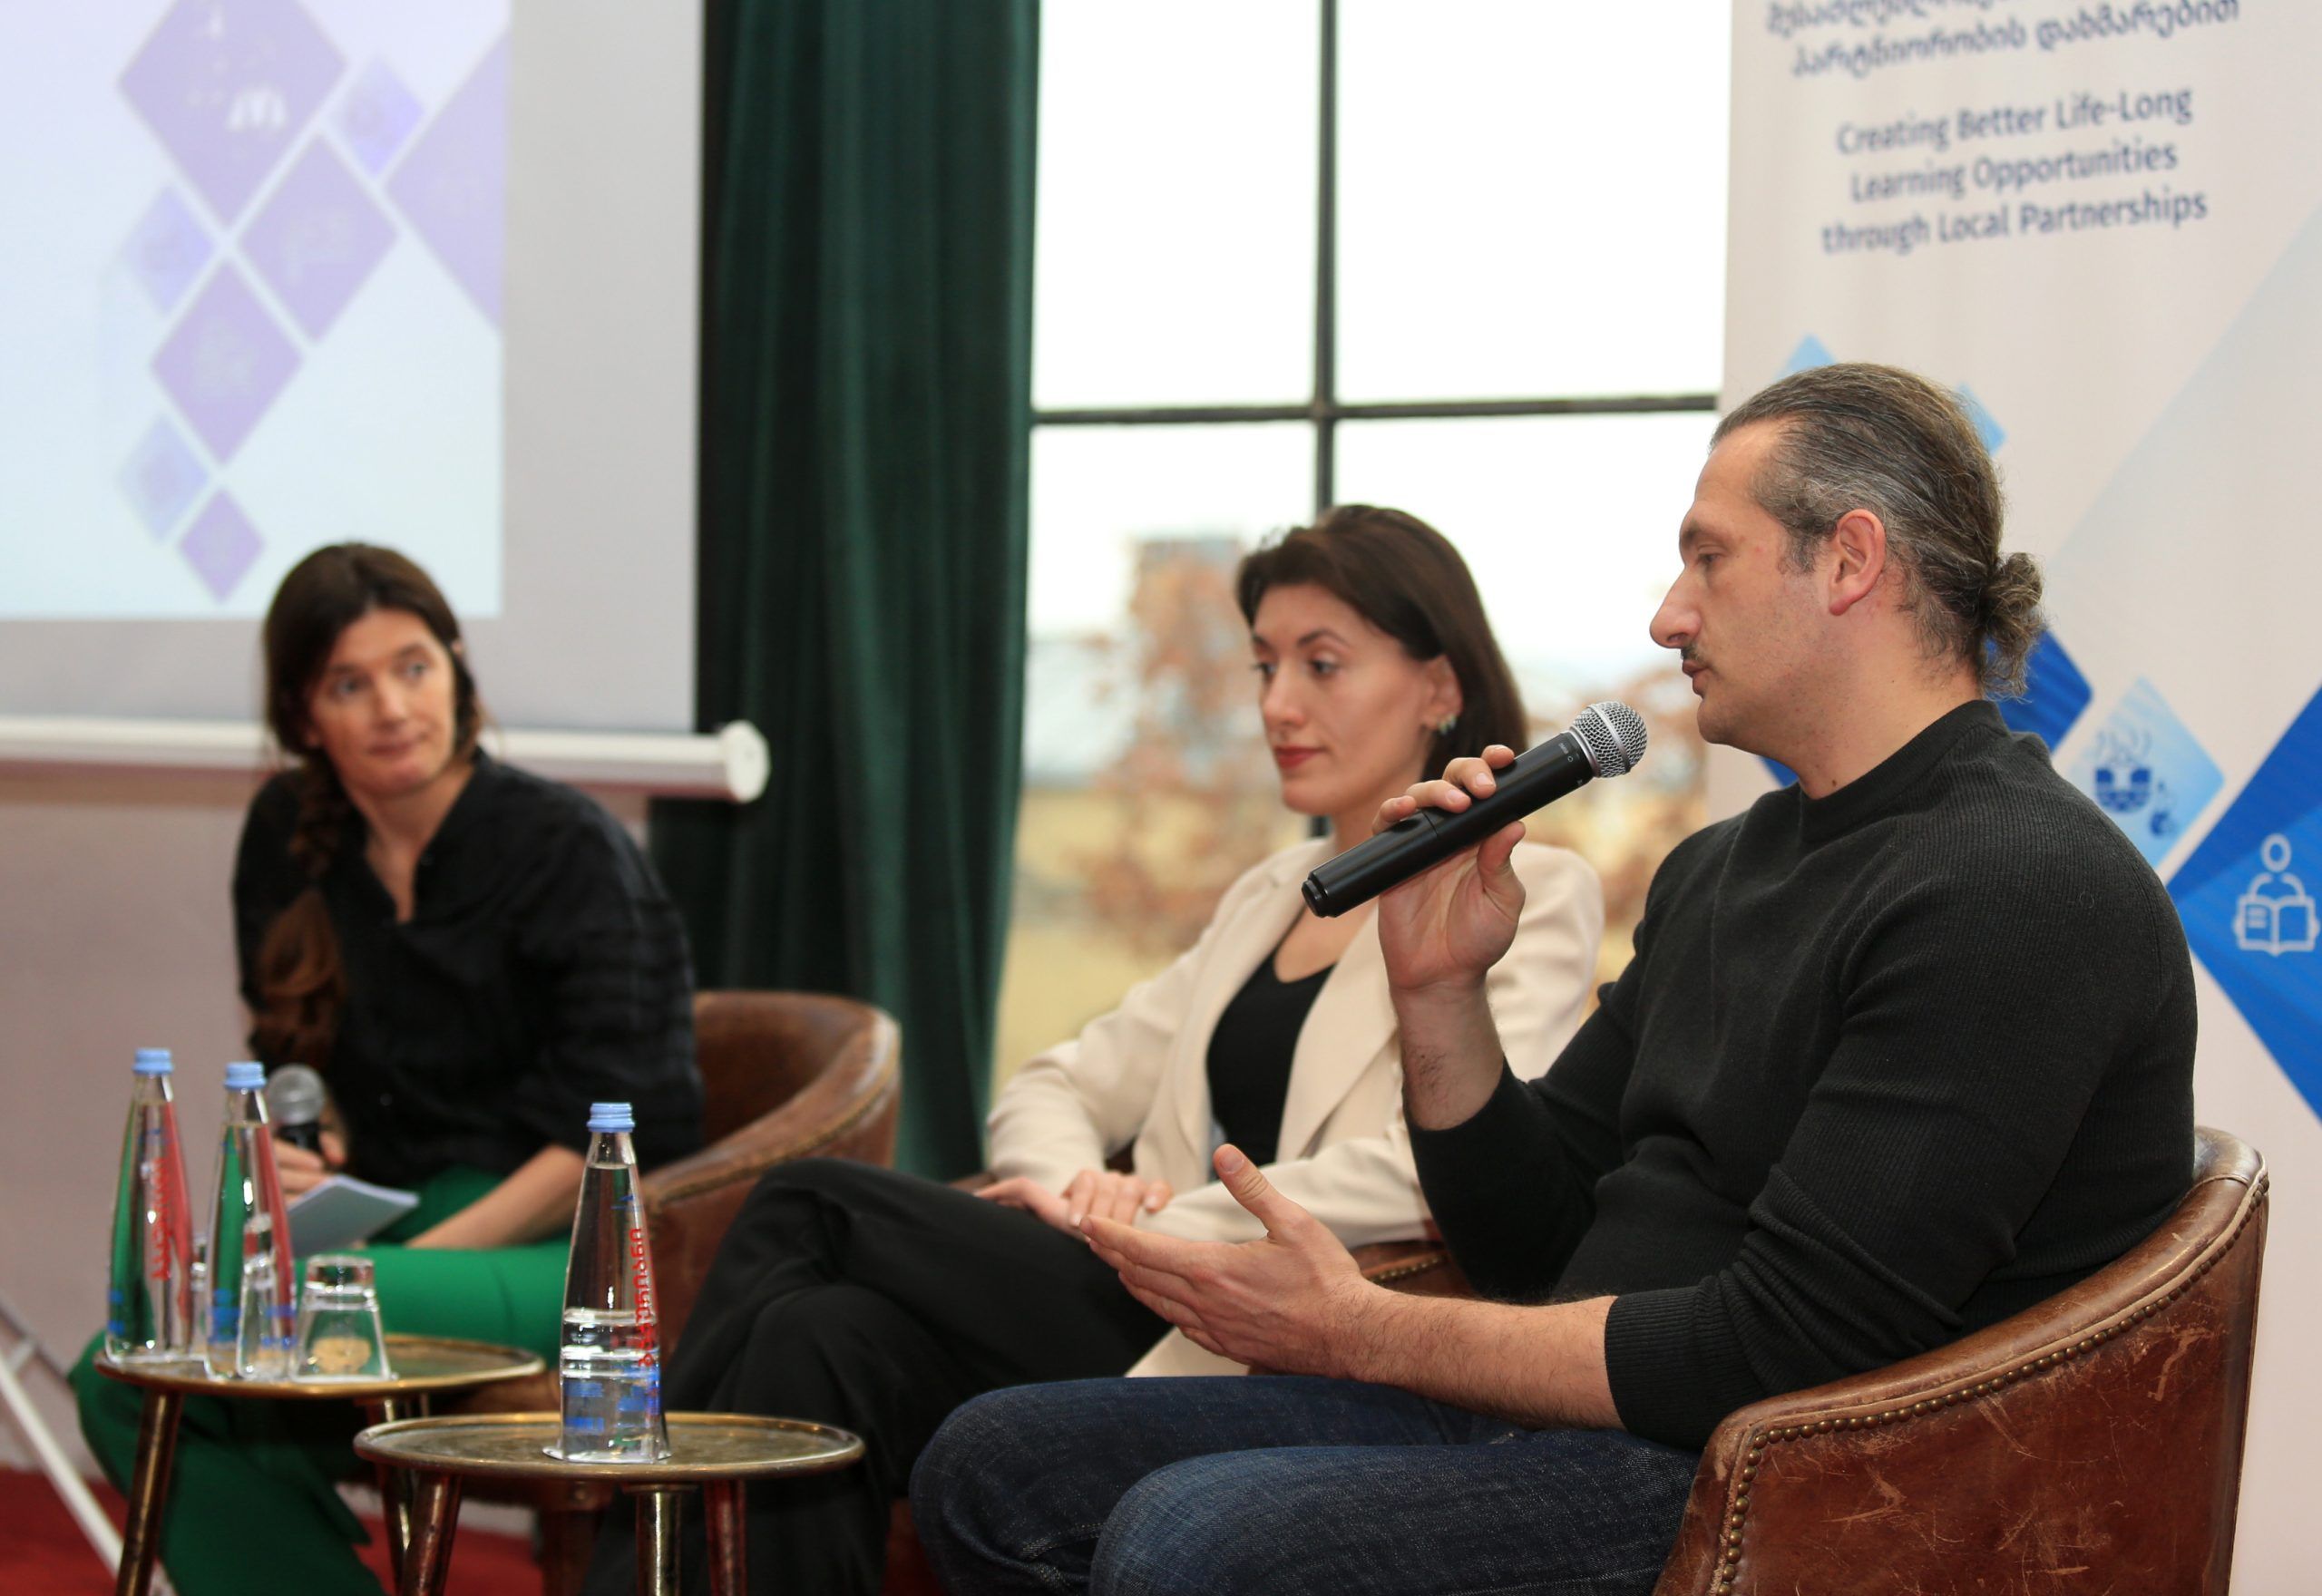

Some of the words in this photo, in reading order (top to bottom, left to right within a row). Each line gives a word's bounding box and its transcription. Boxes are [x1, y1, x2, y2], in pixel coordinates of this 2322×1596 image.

[1837, 113, 1949, 155] Creating
[1957, 107, 2046, 141] Better
[2056, 89, 2193, 131] Life-Long
[1852, 165, 1966, 203] Learning
[1974, 139, 2178, 194] Opportunities
[1821, 216, 1929, 256] through
[1938, 207, 2010, 243] Local
[2020, 188, 2208, 234] Partnerships
